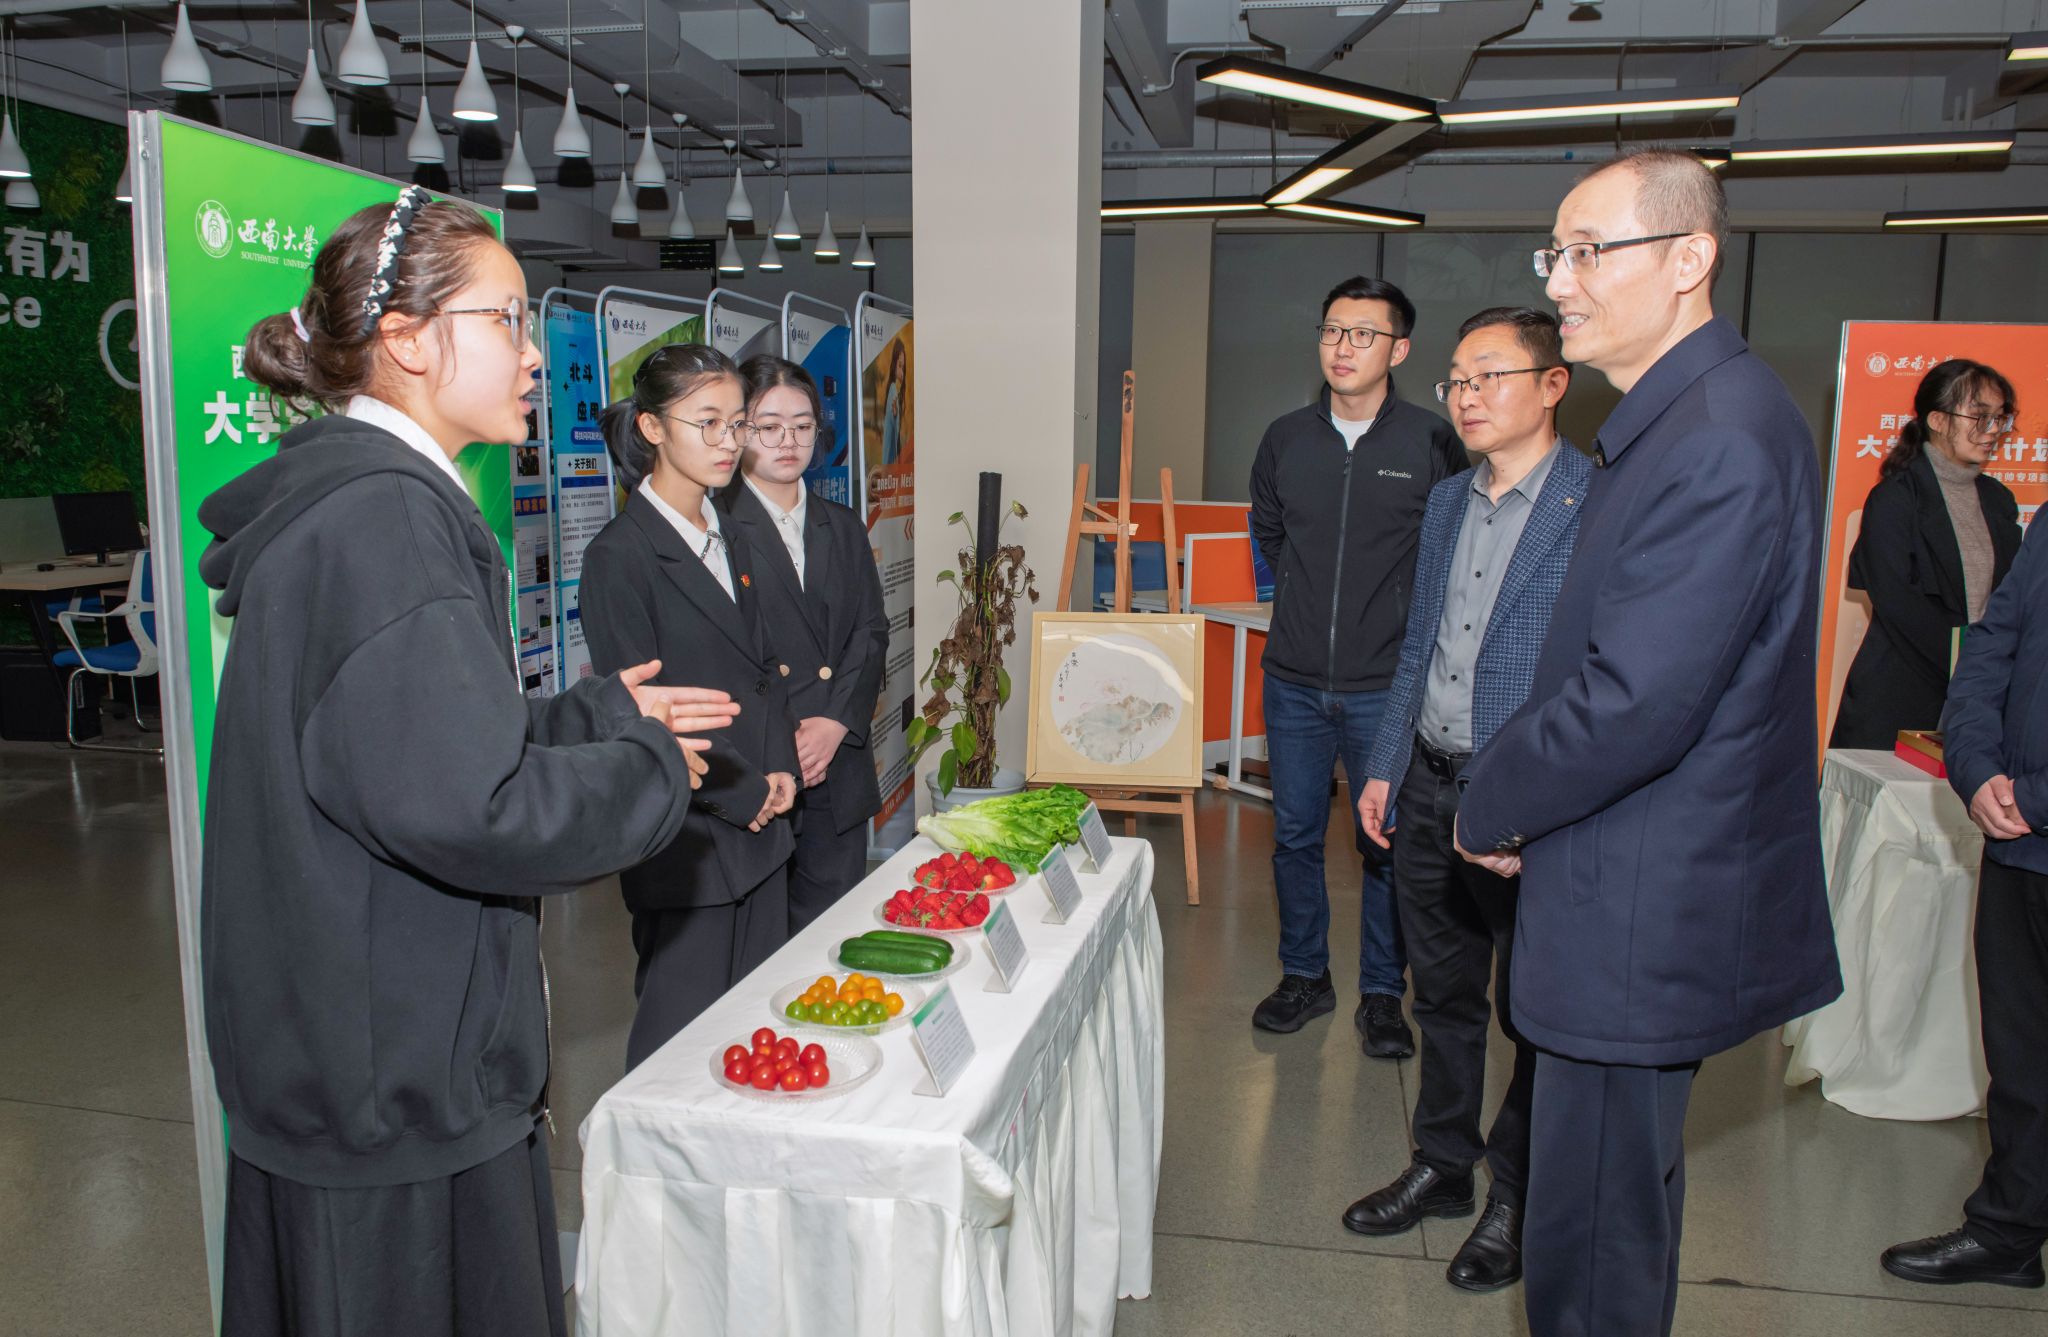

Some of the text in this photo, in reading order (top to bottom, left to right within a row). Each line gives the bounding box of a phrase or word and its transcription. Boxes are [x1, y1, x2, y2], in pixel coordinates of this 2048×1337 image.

[0, 226, 90, 283] 有为
[1894, 355, 1954, 371] 西南大
[569, 362, 593, 384] 北斗
[577, 401, 599, 421] 应用
[574, 458, 597, 470] 关于我们
[1384, 469, 1412, 479] Columbia
